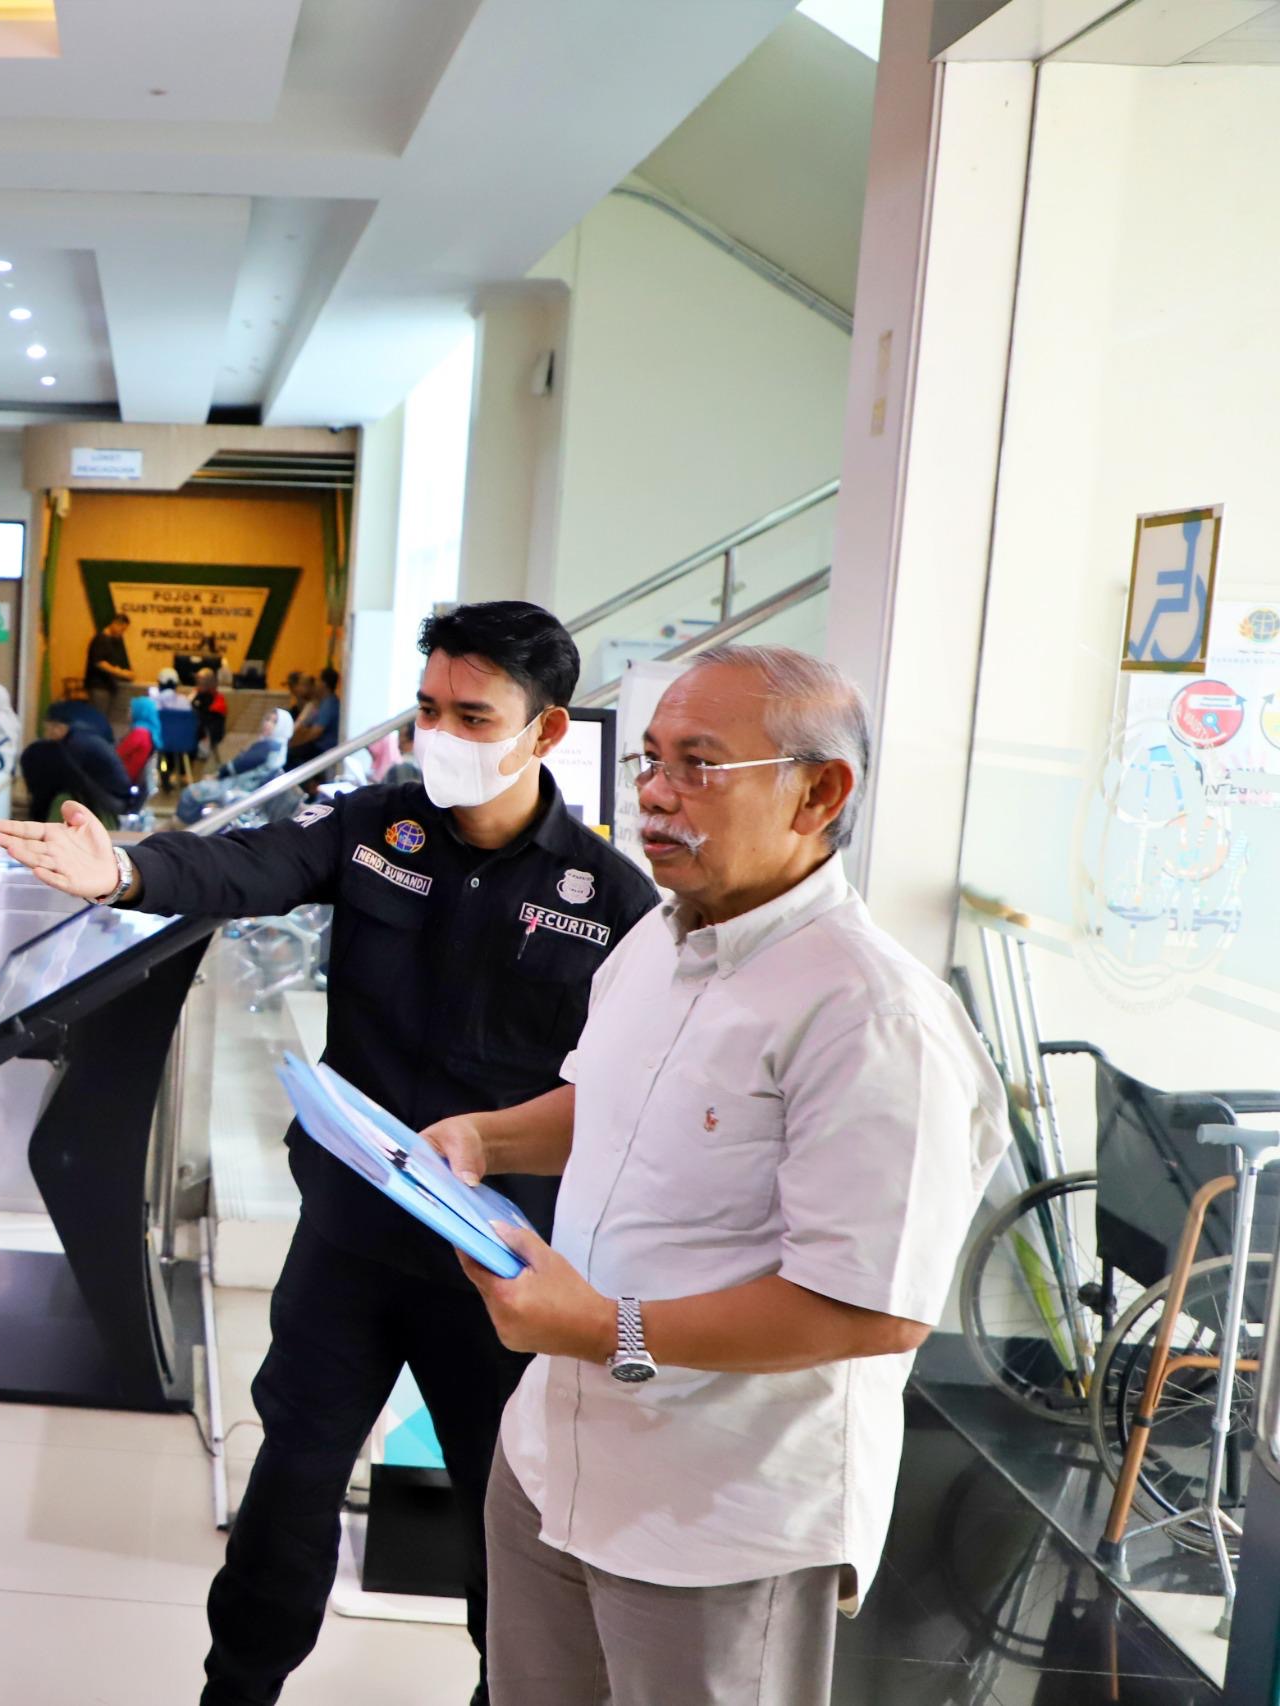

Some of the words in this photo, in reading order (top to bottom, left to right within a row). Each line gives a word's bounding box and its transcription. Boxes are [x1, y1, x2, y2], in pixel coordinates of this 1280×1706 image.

[153, 591, 202, 602] POJOK
[122, 603, 193, 615] CUSTOMER
[201, 606, 253, 617] SERVICE
[173, 617, 202, 627] DAN
[147, 641, 228, 653] PENGADN
[357, 849, 385, 870] NENDI
[384, 865, 427, 892] SUWANDI
[524, 907, 607, 941] SECURITY
